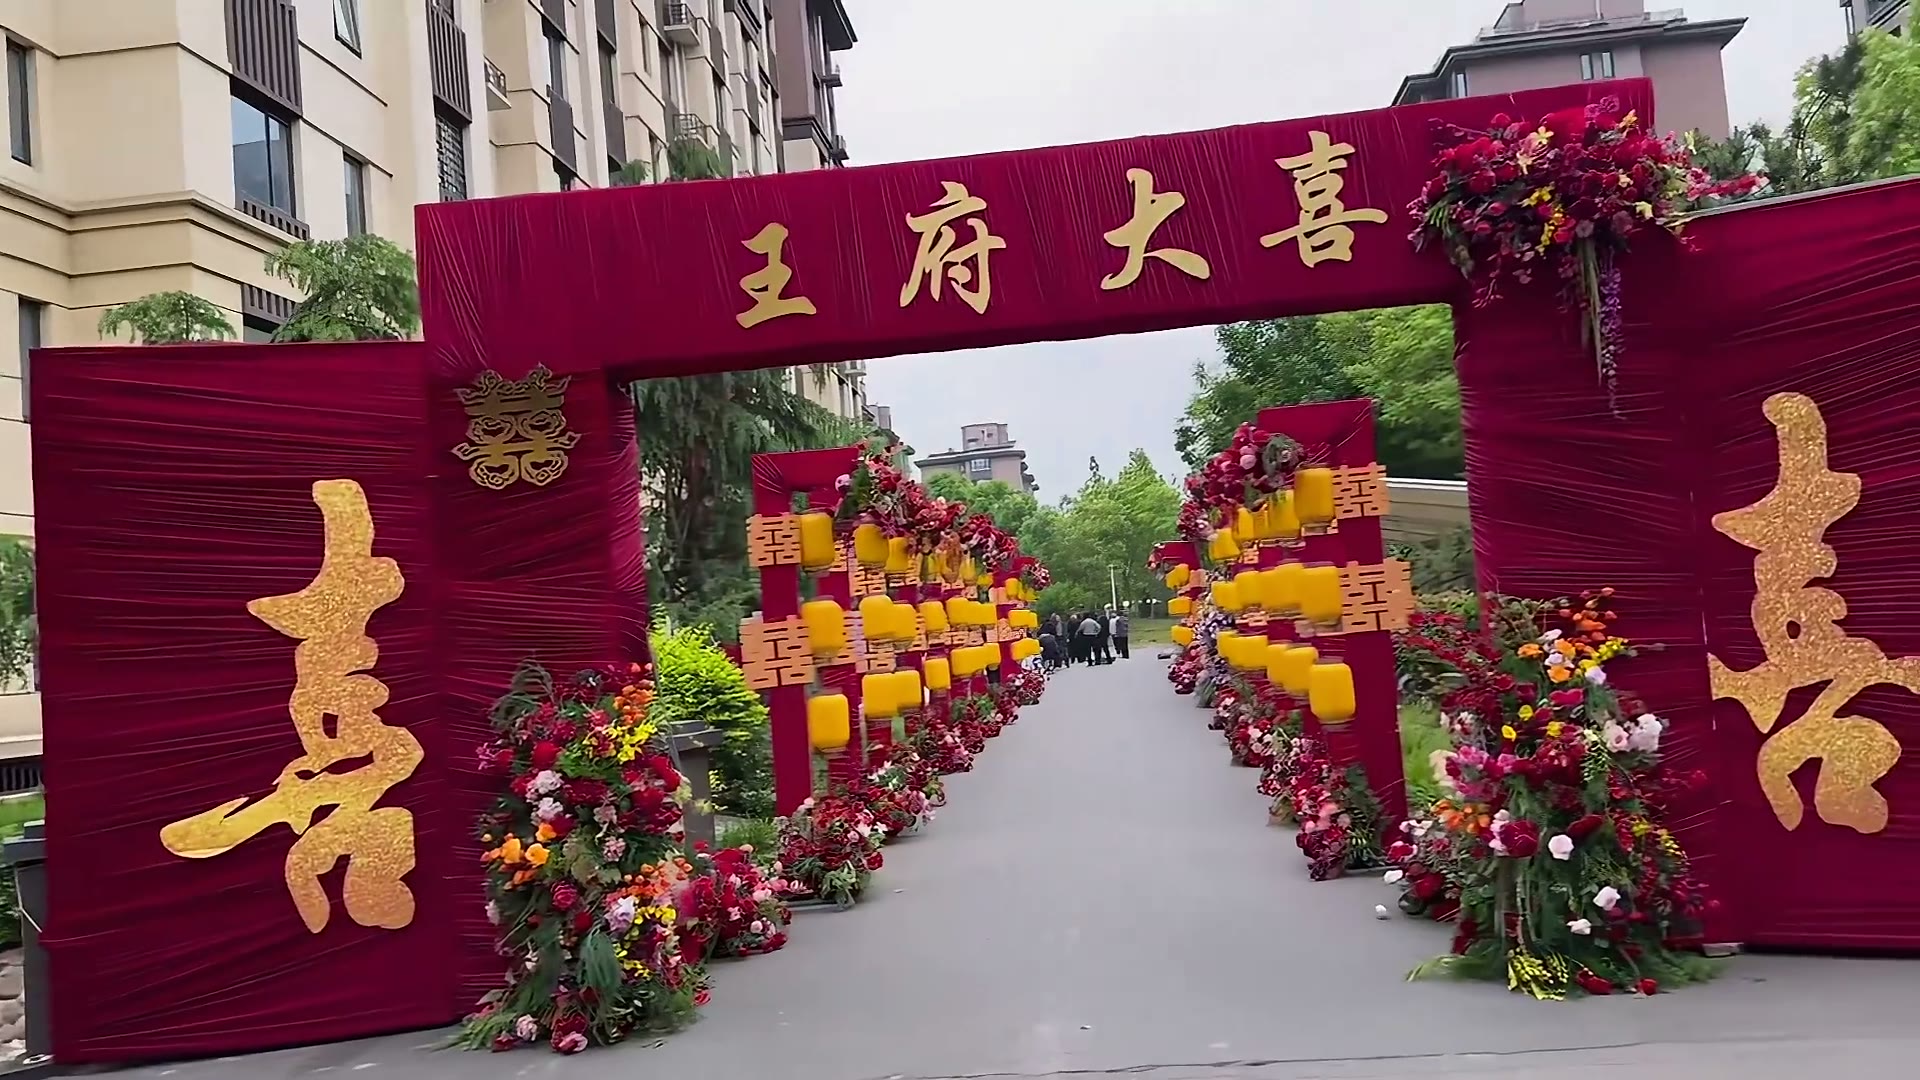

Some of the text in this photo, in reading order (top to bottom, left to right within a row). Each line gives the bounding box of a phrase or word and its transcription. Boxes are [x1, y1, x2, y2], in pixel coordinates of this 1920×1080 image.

[735, 130, 1388, 330] 王府大喜
[160, 478, 425, 934] 喜
[1707, 391, 1920, 834] 喜
